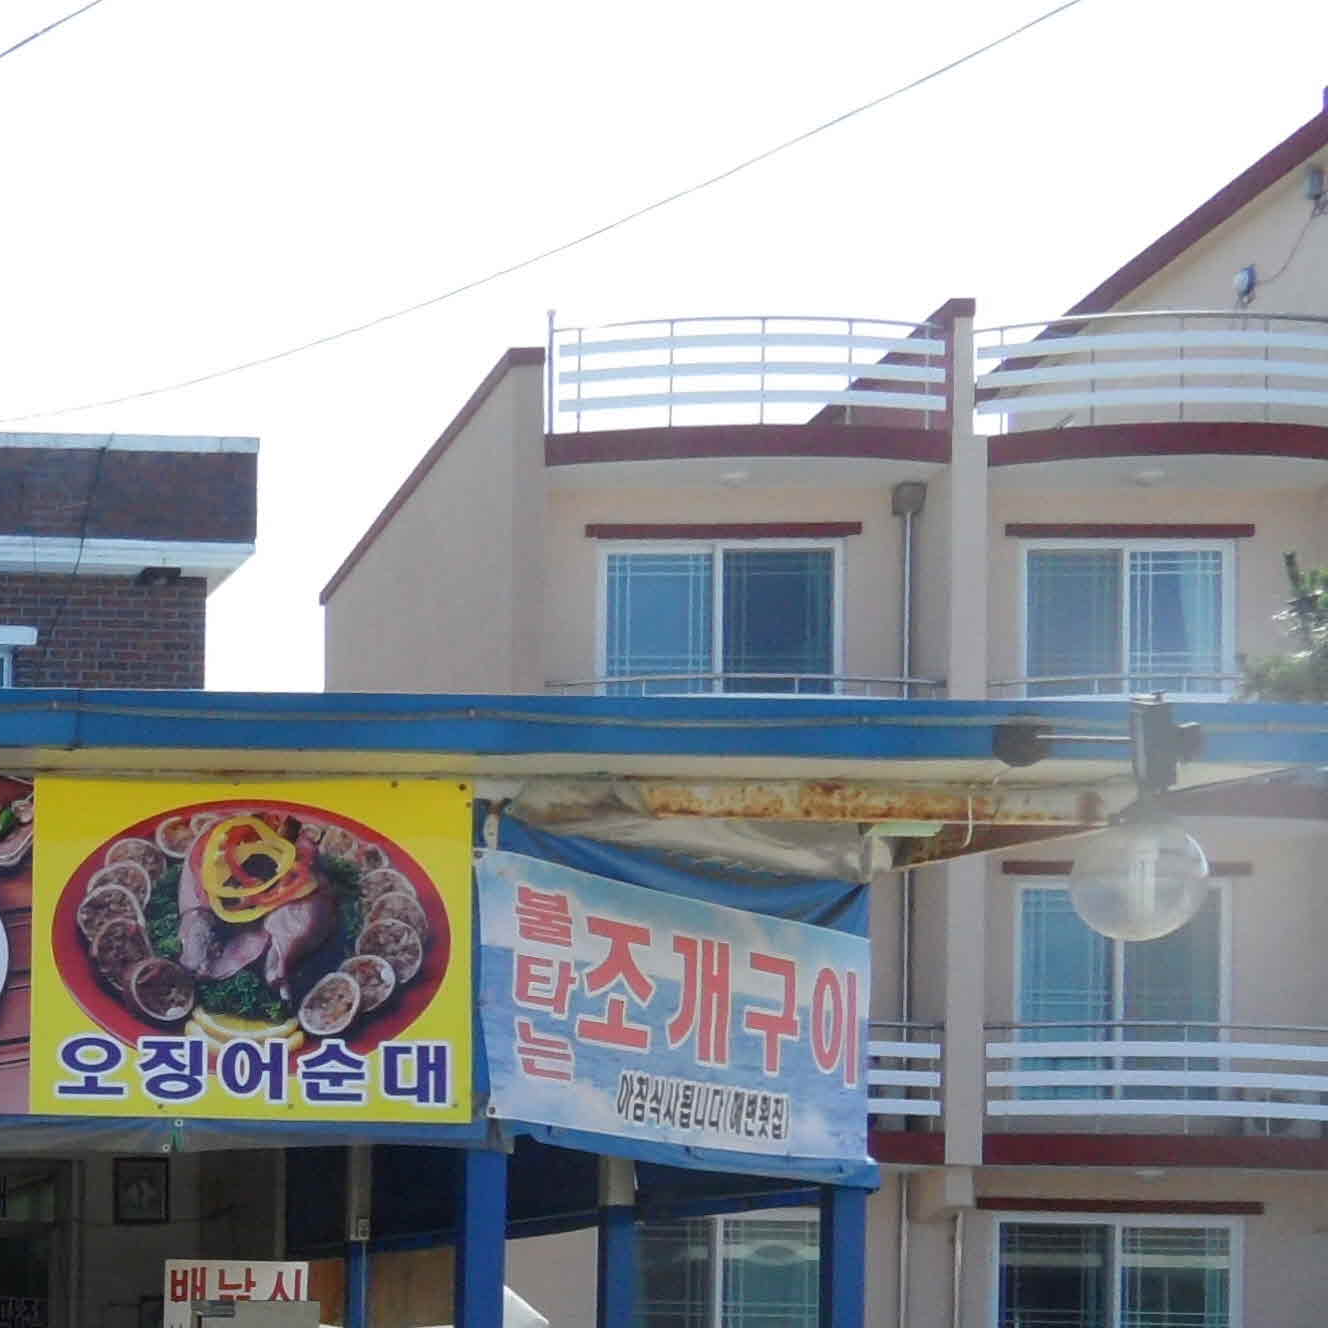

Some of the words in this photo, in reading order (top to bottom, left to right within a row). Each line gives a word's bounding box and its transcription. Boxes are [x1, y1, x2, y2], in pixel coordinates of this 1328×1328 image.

[513, 883, 576, 1082] 불타는
[576, 914, 859, 1088] 조개구이
[55, 1034, 452, 1108] 오징어순대
